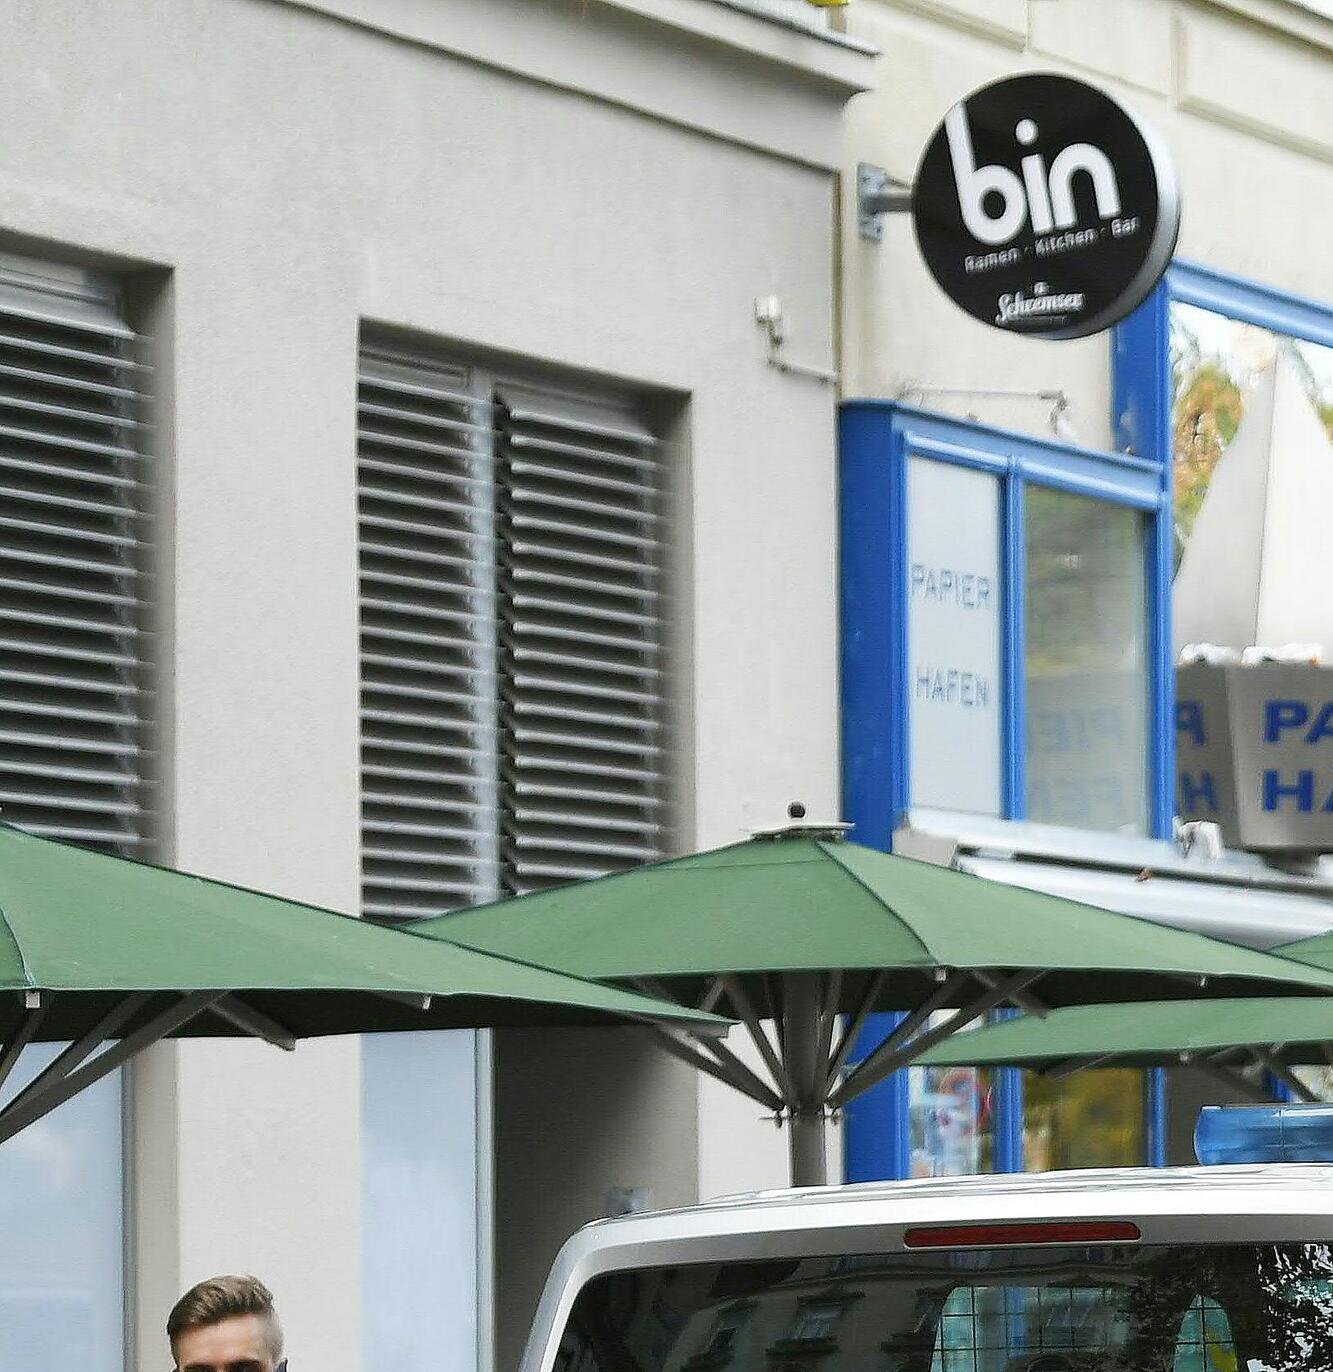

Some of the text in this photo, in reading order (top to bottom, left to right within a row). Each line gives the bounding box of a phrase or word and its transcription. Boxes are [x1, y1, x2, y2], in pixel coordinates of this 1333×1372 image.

[945, 102, 1121, 246] bin
[1035, 228, 1096, 256] Kitchen
[1111, 216, 1141, 237] Bar
[911, 564, 991, 609] PAPIER
[916, 666, 990, 706] HAFEN
